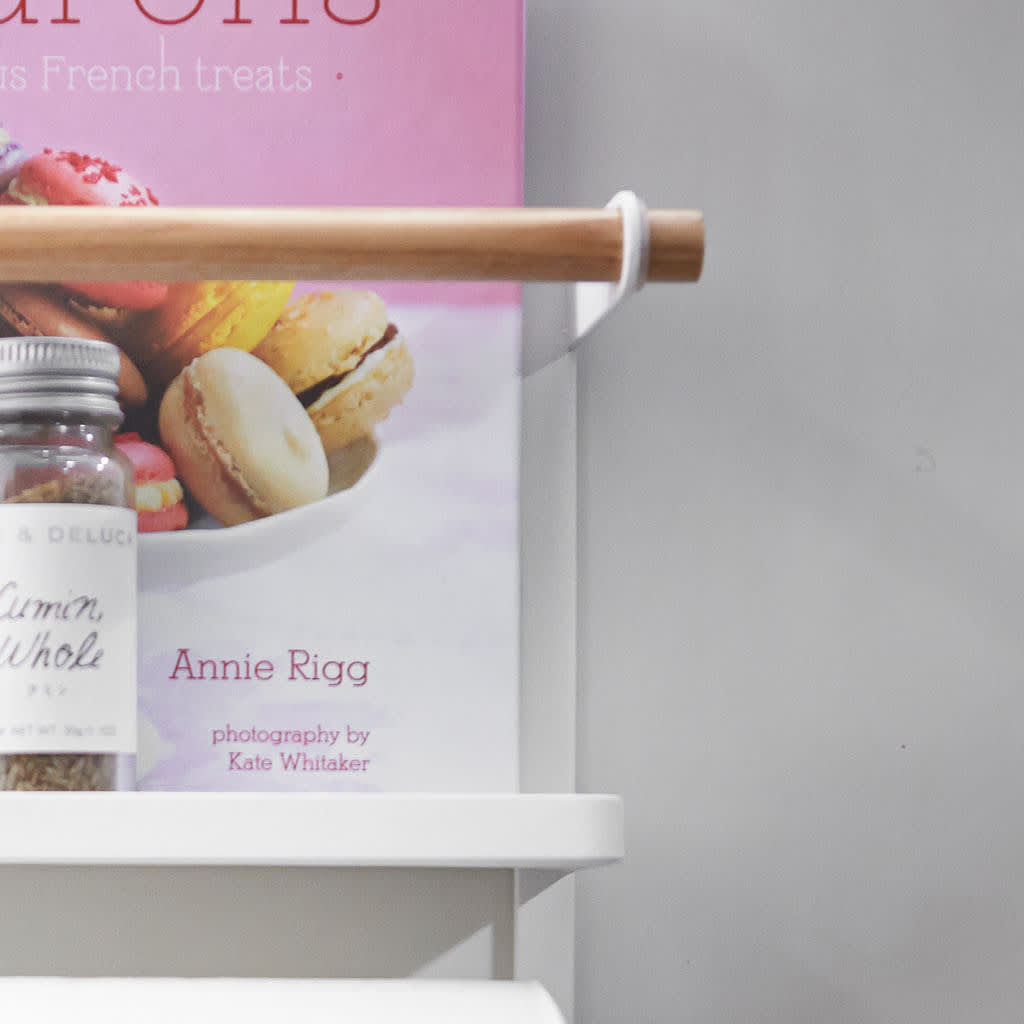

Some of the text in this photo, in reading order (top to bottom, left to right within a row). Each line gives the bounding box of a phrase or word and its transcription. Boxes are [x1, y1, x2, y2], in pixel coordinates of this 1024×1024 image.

[41, 35, 181, 91] French
[197, 55, 312, 92] treats
[168, 648, 371, 687] Annie Rigg
[212, 724, 371, 746] photography by
[228, 752, 371, 772] Kate Whitaker
